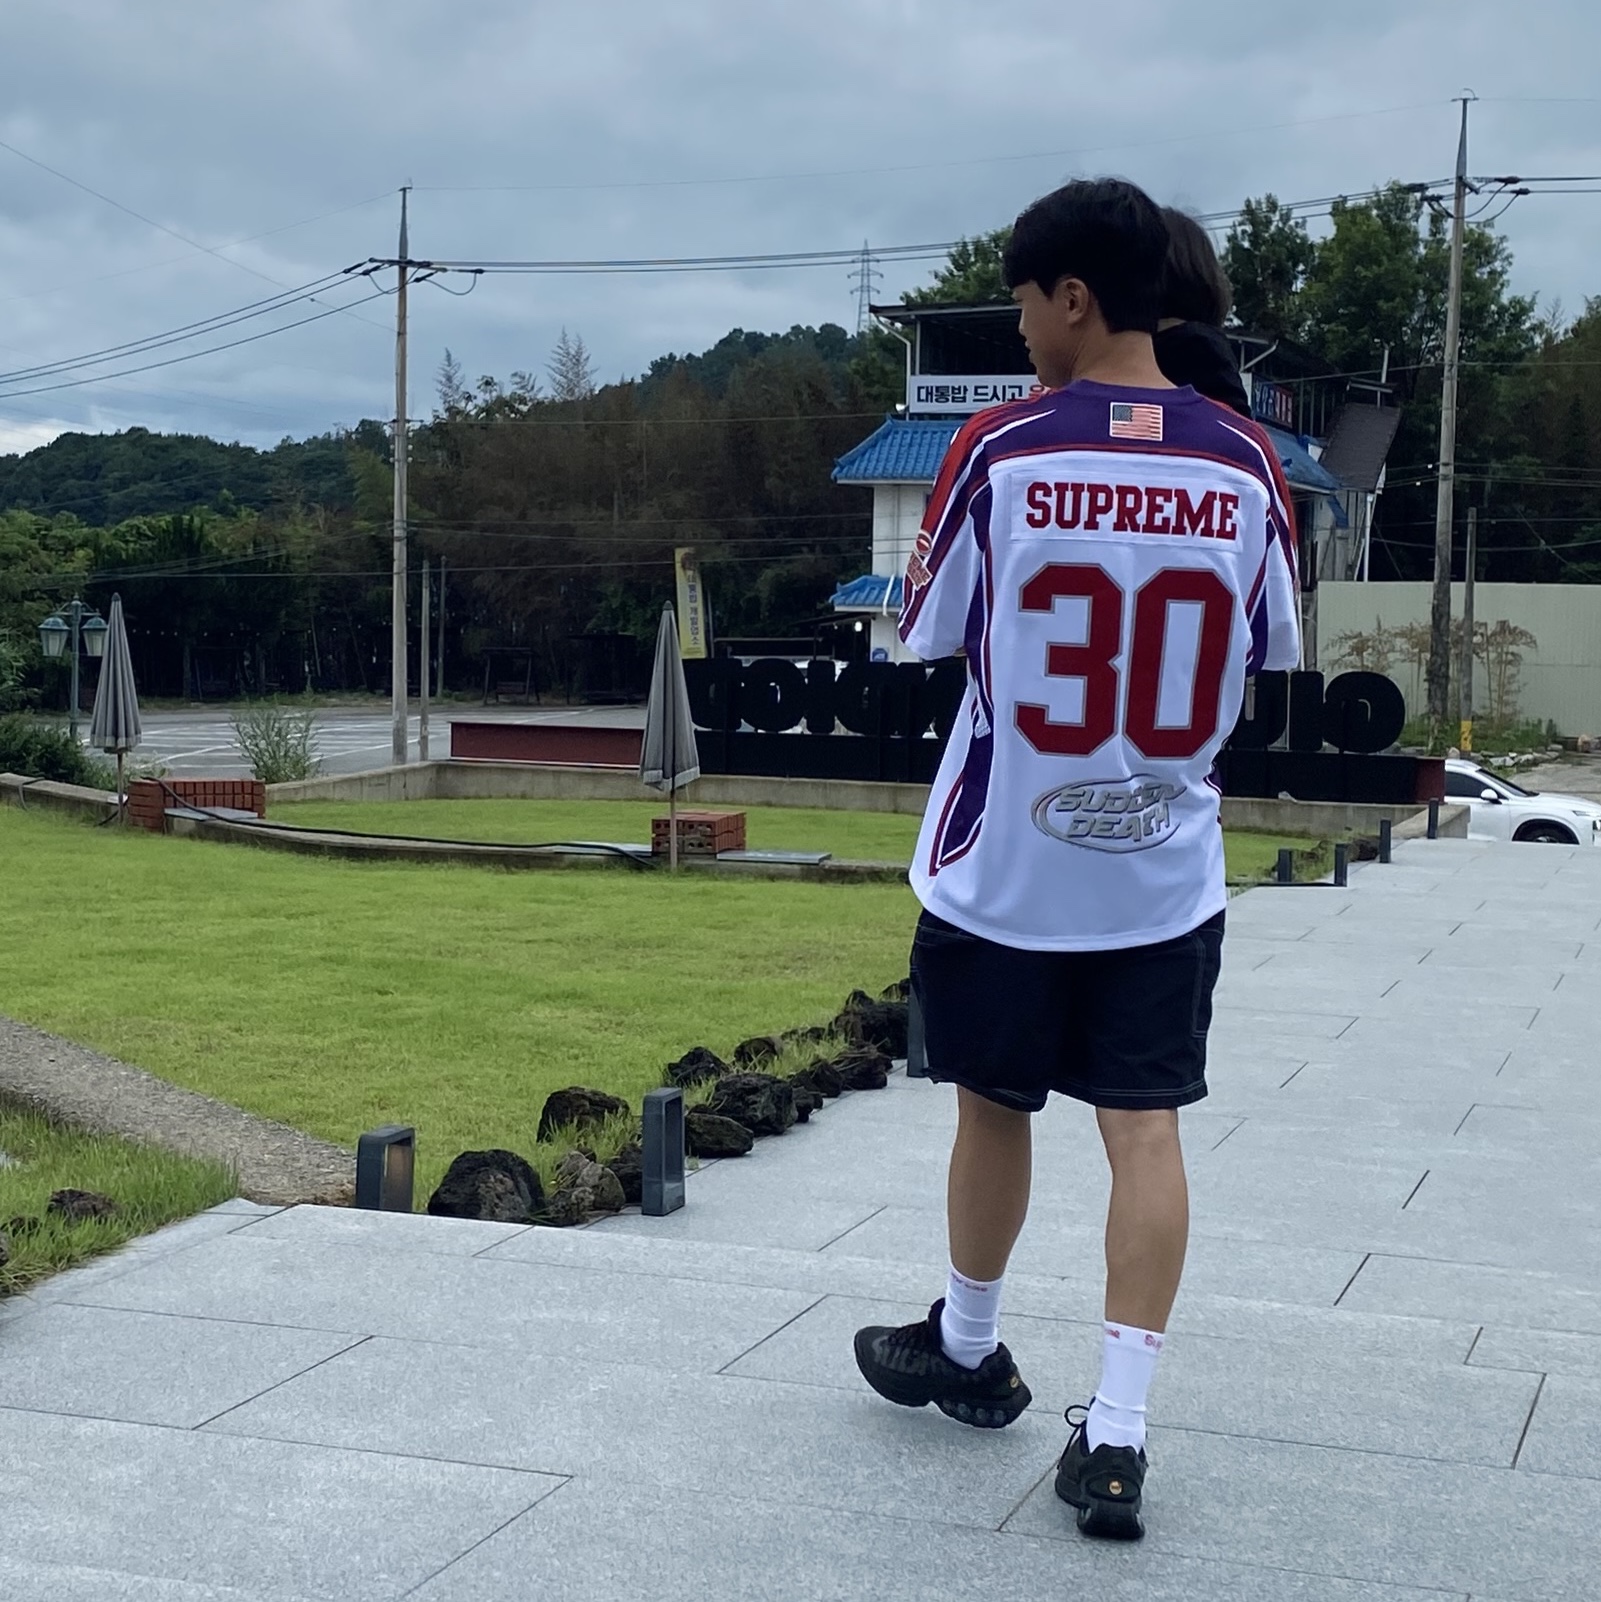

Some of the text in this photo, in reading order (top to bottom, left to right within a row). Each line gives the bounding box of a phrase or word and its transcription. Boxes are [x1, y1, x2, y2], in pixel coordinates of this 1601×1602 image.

[917, 385, 968, 403] 대통밥
[973, 385, 1023, 403] 드시고
[1026, 481, 1239, 540] SUPREME
[1013, 561, 1237, 760] 30
[1067, 802, 1170, 842] DEATH
